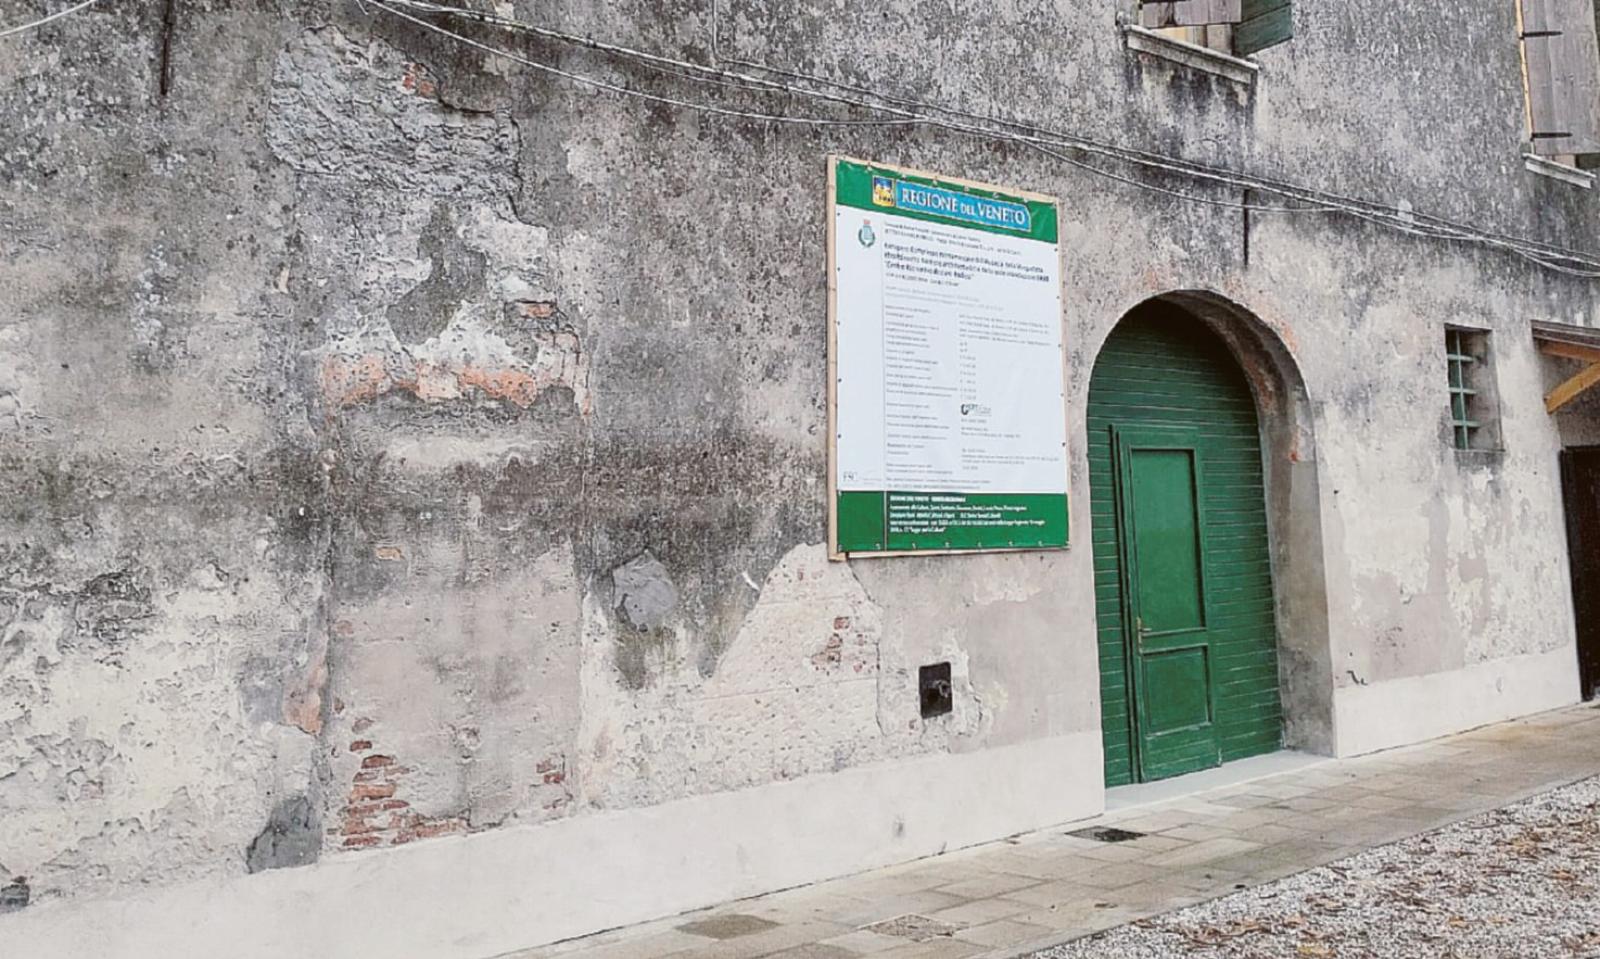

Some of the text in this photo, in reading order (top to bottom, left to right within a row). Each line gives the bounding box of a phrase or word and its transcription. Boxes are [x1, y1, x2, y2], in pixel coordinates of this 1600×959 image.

[901, 187, 1026, 225] REGIONE DEL VENETO
